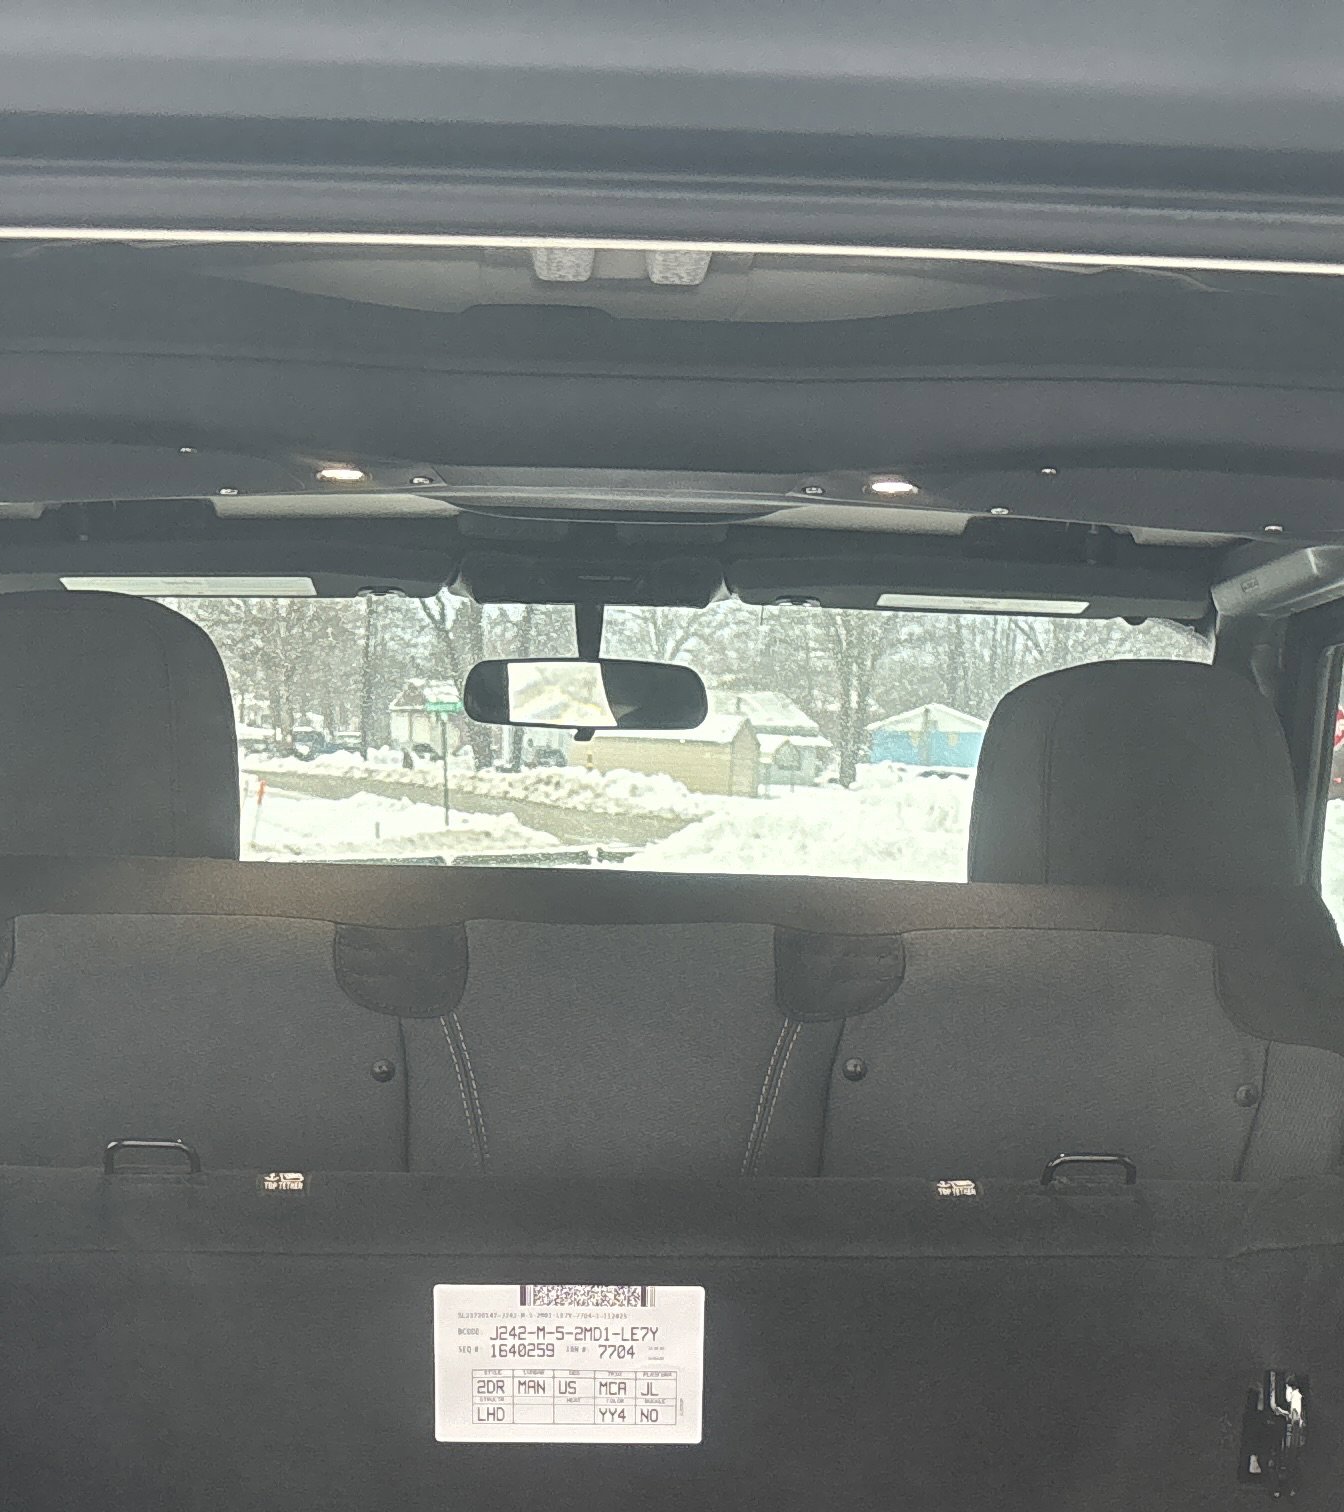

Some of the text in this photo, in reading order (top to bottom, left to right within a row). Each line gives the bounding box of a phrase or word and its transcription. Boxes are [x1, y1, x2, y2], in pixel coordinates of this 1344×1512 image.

[489, 1325, 659, 1342] J242-M-5-2MD1-LE7Y
[490, 1343, 555, 1358] 1640259
[598, 1344, 636, 1359] 7704
[477, 1380, 505, 1394] 2DR
[518, 1380, 546, 1395] MAN
[558, 1380, 577, 1395] US
[598, 1381, 627, 1396] MCA
[640, 1382, 659, 1396] JL
[477, 1407, 505, 1421] LHD
[598, 1408, 626, 1422] YY4
[640, 1408, 659, 1423] NO
